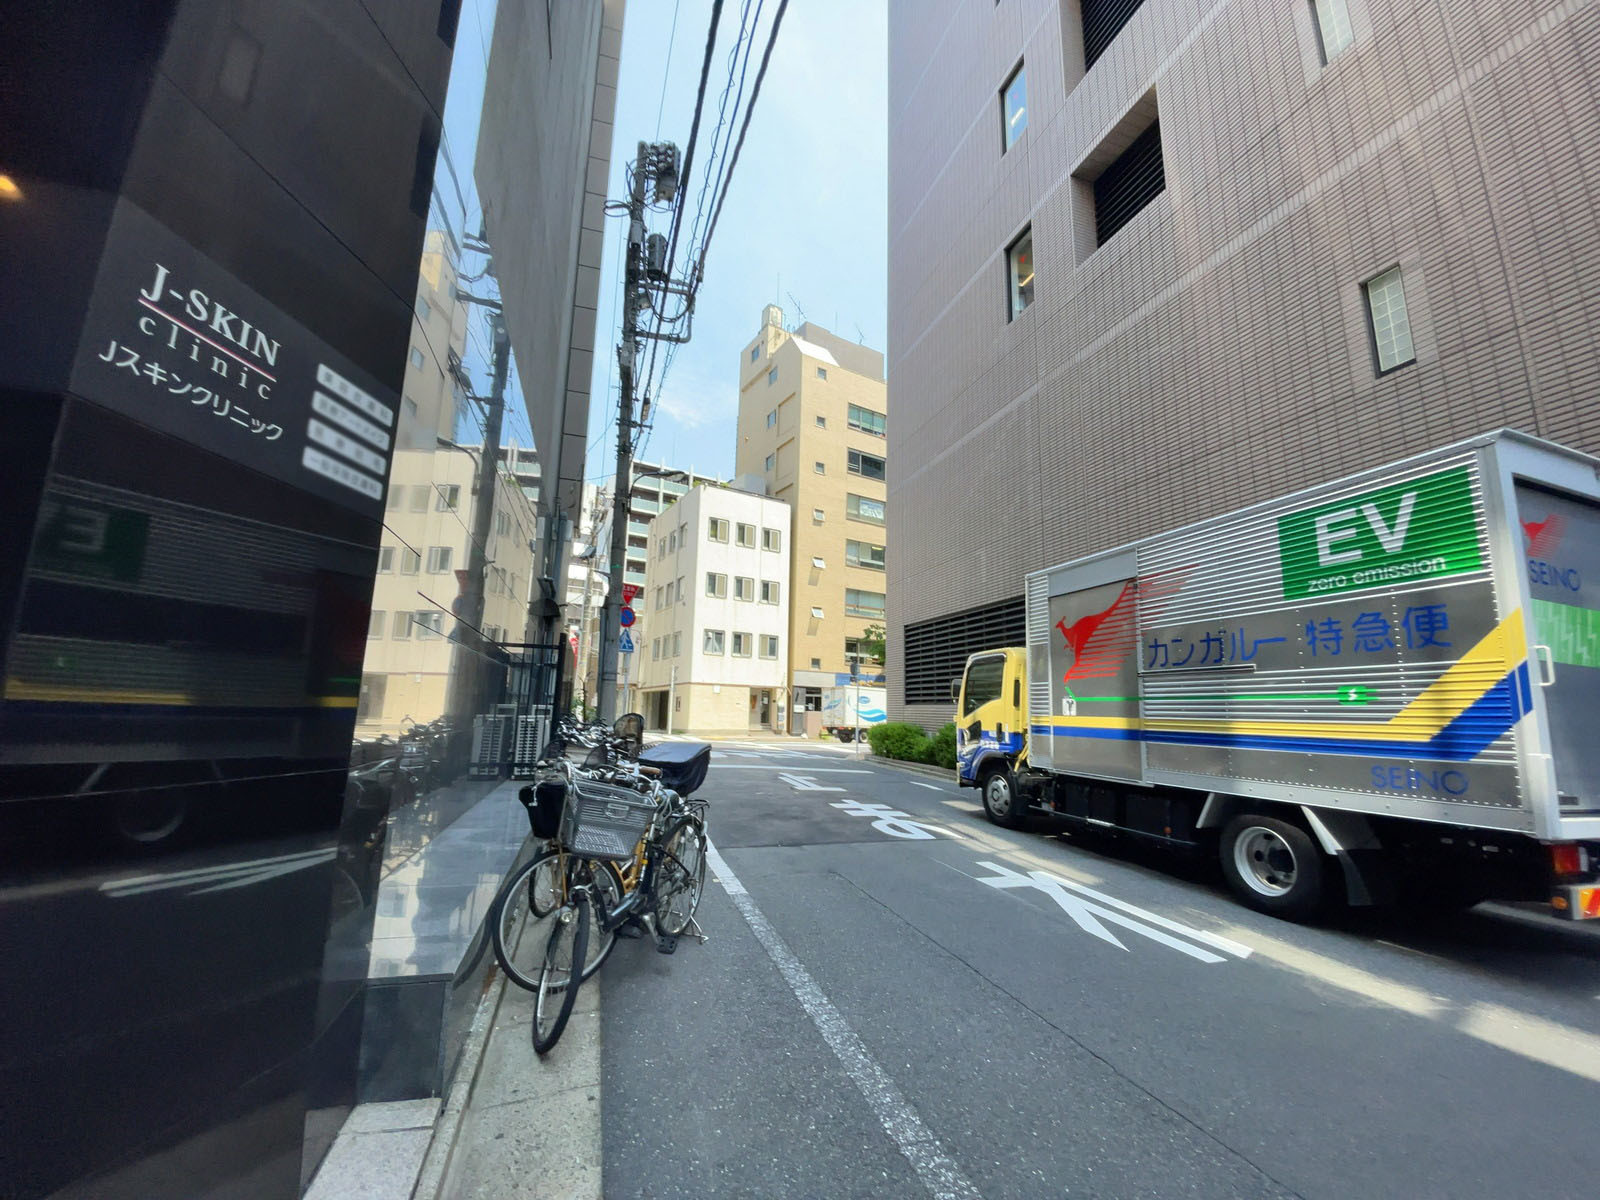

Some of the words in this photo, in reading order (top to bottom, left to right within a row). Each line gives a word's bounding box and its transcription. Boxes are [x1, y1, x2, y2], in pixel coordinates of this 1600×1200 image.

[141, 263, 281, 367] J-SKIN
[99, 340, 283, 441] Jスキンクリニック
[139, 314, 272, 400] clinic
[1315, 491, 1417, 566] EV
[1308, 569, 1348, 592] zero
[1352, 555, 1446, 584] emission
[1528, 559, 1581, 592] SEINO
[1148, 629, 1287, 669] カンガルー
[1305, 603, 1451, 657] 特急便
[1371, 764, 1469, 795] SEINO
